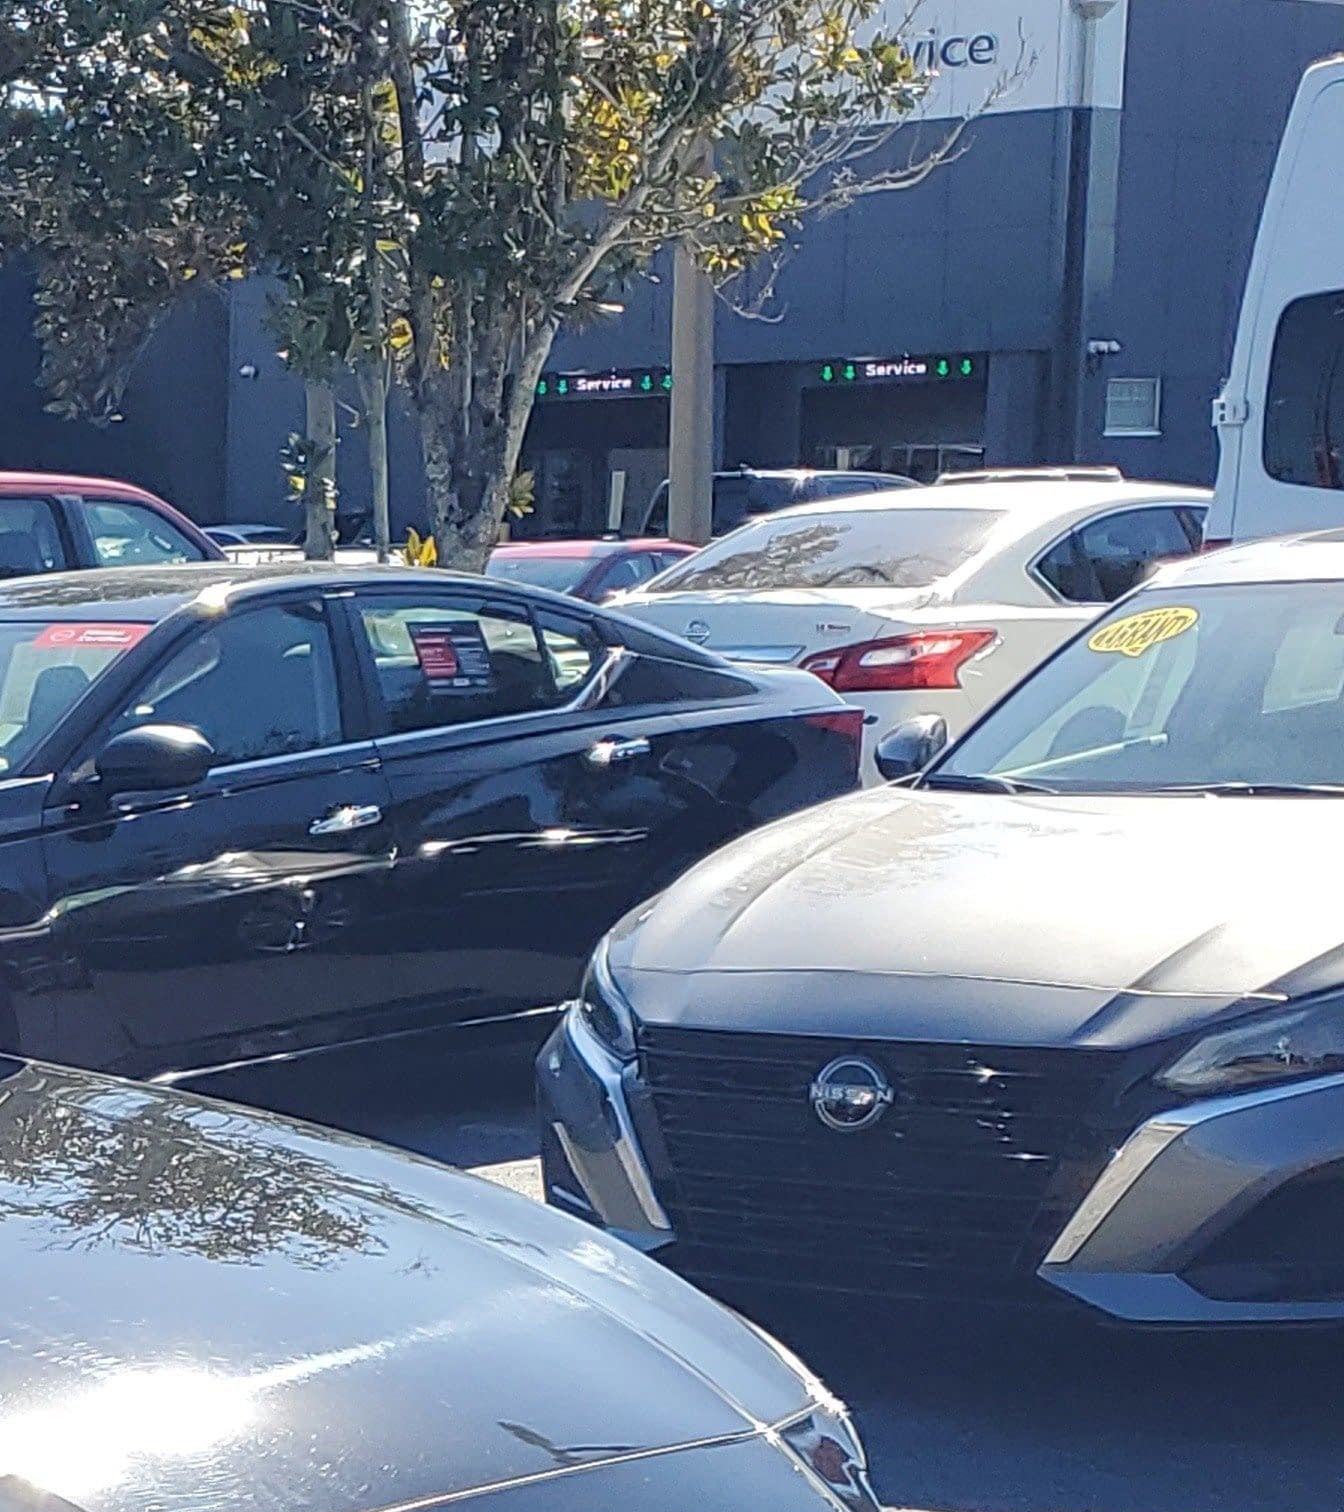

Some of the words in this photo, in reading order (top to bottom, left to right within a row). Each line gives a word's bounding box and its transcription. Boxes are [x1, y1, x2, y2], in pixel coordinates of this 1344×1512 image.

[901, 27, 997, 68] vice
[864, 359, 927, 377] Service
[576, 374, 632, 392] Service
